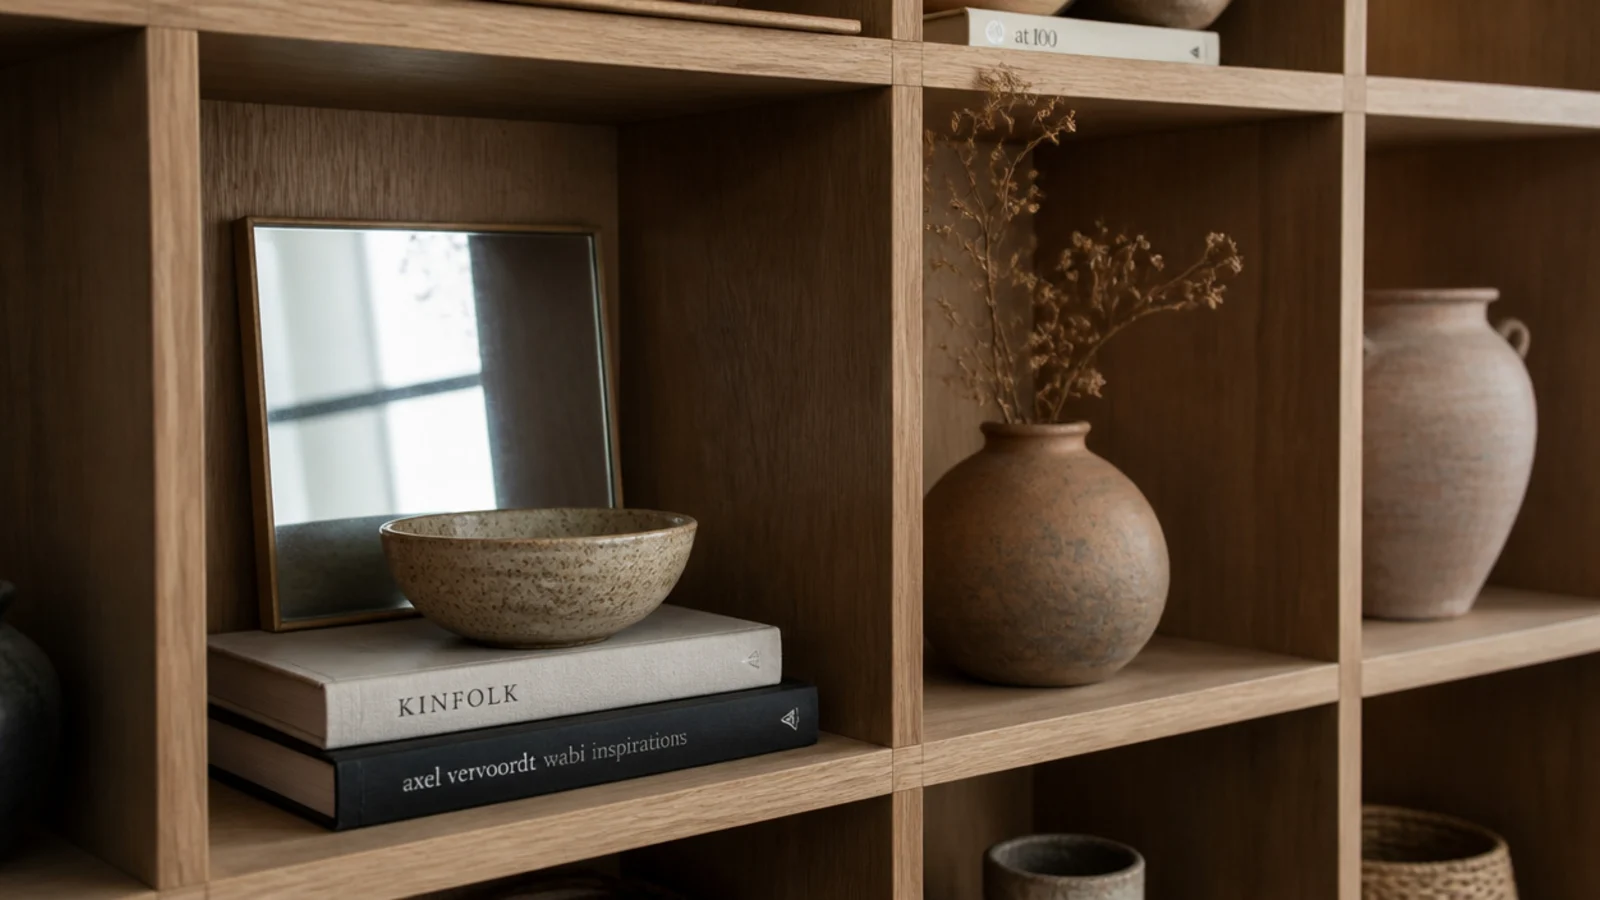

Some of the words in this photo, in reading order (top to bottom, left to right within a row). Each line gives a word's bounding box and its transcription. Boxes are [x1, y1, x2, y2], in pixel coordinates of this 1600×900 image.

[1014, 28, 1029, 45] at
[398, 684, 519, 717] KINFOLK
[403, 766, 441, 792] axel
[447, 752, 536, 784] vervoordt
[544, 744, 585, 767] wabi
[592, 732, 687, 762] inspirations
